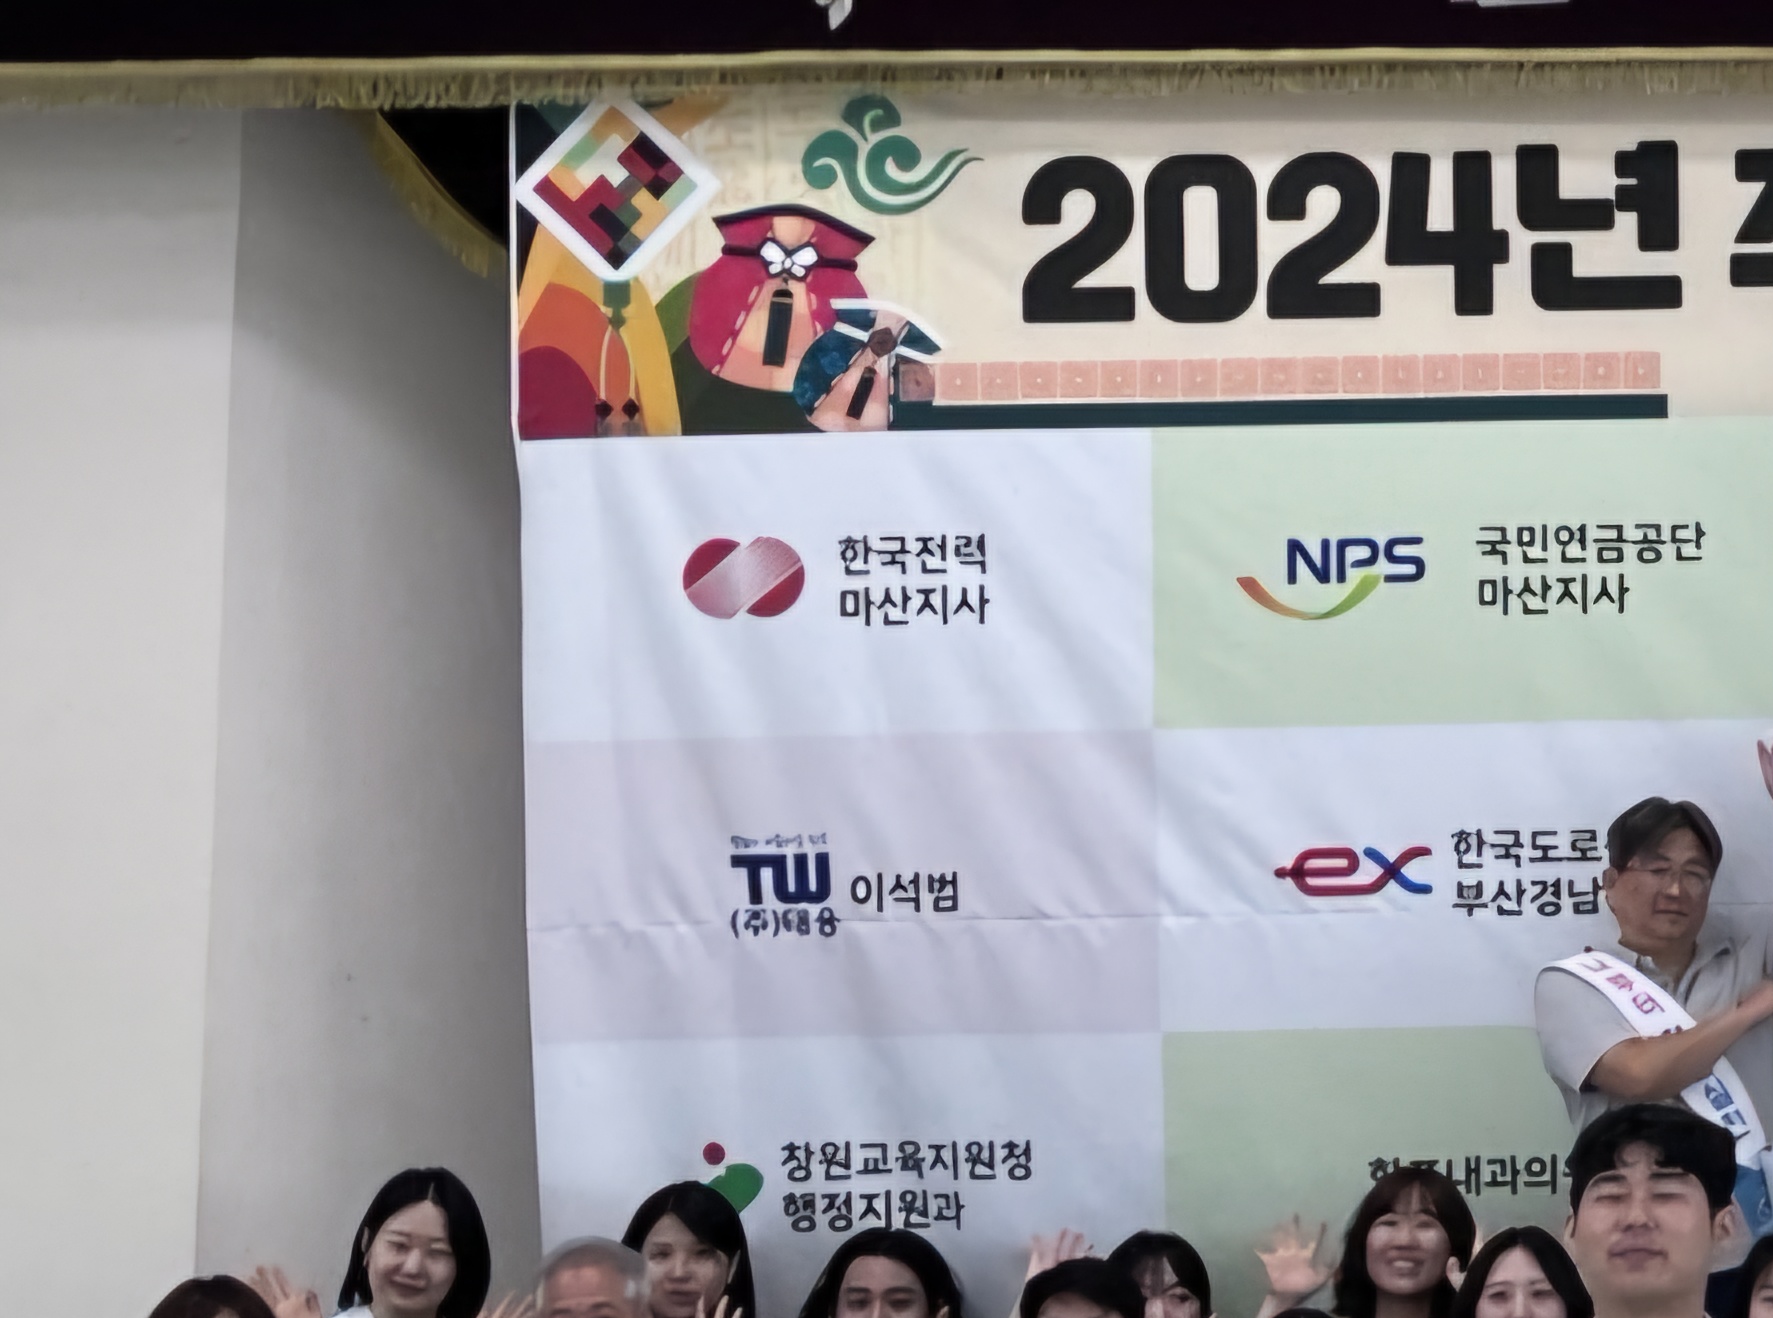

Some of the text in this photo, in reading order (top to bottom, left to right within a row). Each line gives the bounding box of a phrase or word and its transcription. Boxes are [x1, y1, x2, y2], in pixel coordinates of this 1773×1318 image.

[1021, 139, 1683, 324] 2024년
[838, 533, 987, 576] 한국전력
[1280, 532, 1432, 590] NPS
[1475, 521, 1707, 566] 국민연금공단
[839, 584, 991, 627] 마산지사
[1478, 572, 1631, 617] 마산지사
[1273, 846, 1434, 897] ex
[1450, 828, 1603, 870] 한국도로
[730, 851, 832, 906] TW
[850, 870, 959, 913] 이석범
[1451, 875, 1604, 918] 부산경남
[780, 1139, 1032, 1183] 창원교육지원청
[779, 1186, 968, 1234] 행정지원과
